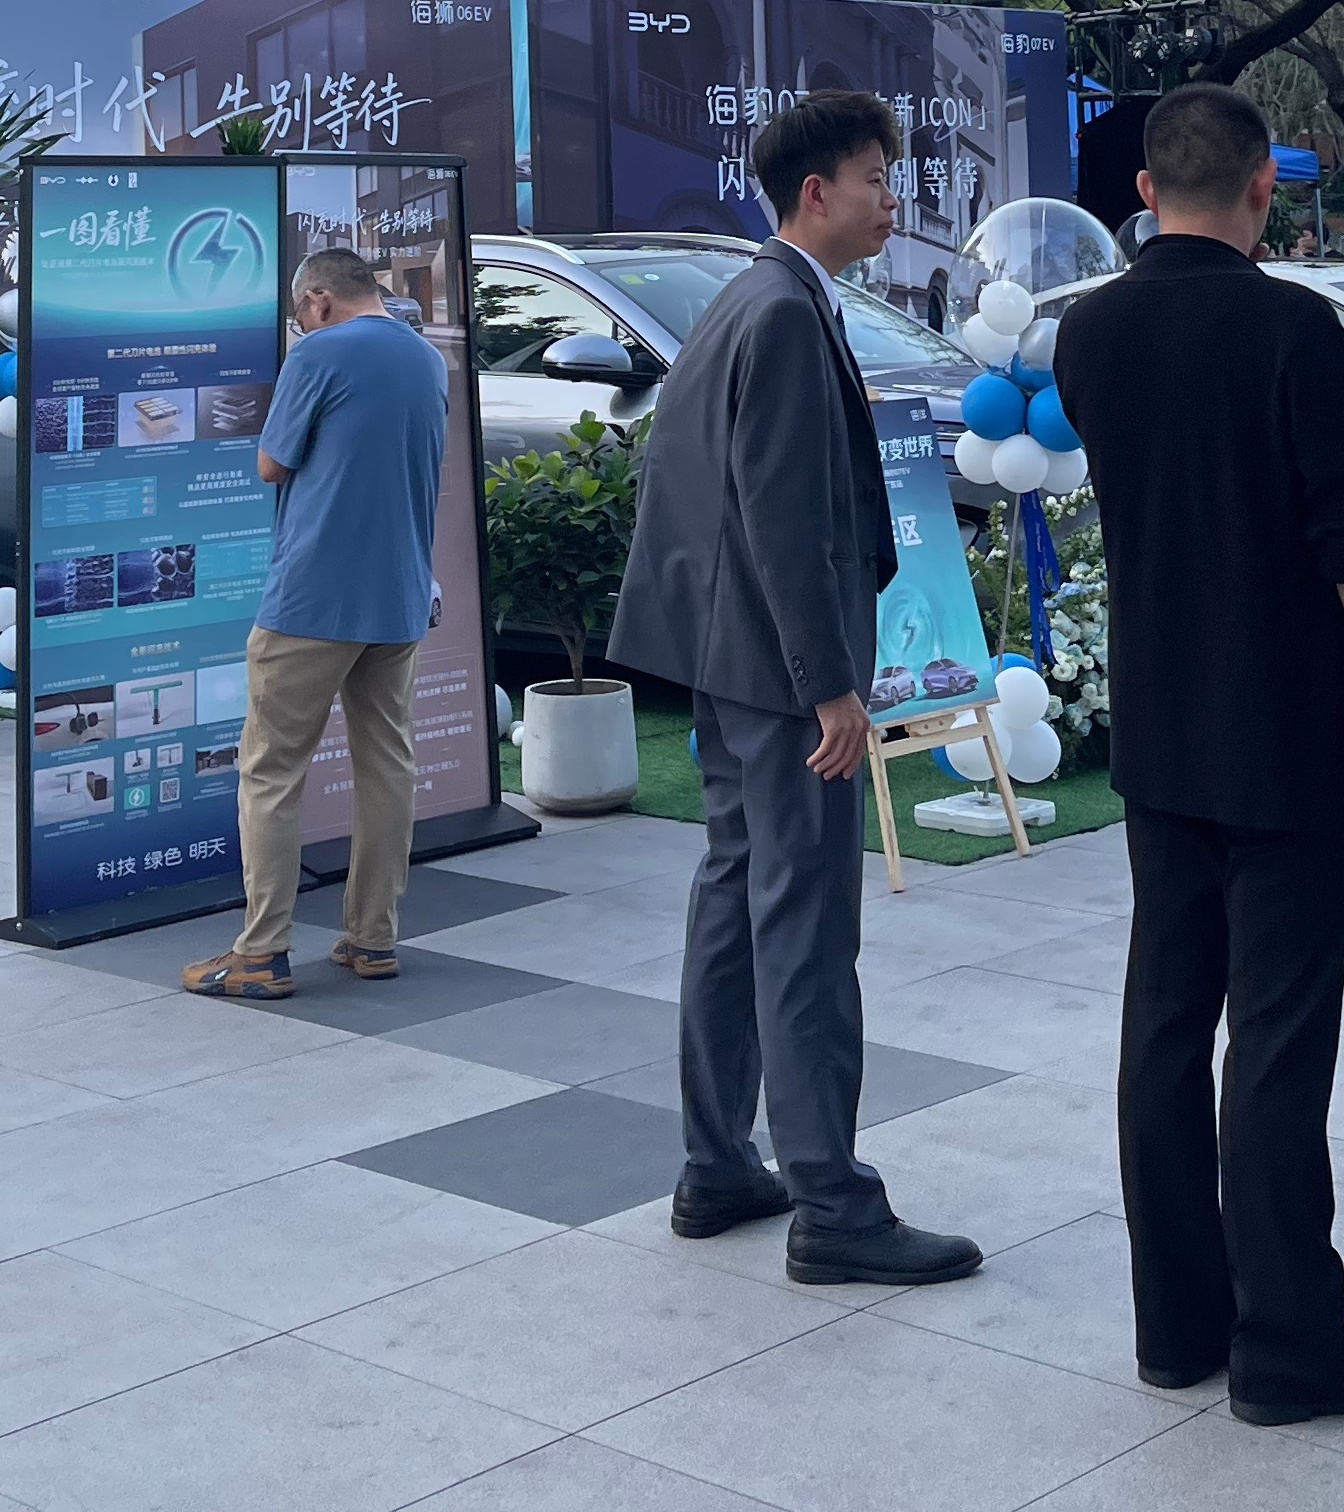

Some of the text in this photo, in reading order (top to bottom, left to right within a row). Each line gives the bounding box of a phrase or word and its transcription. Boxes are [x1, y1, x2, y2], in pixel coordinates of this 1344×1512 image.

[628, 11, 691, 34] BYD
[39, 205, 157, 254] 一图看懂
[371, 206, 443, 238] 告别等待
[96, 836, 228, 882] 科技 绿色 明天
